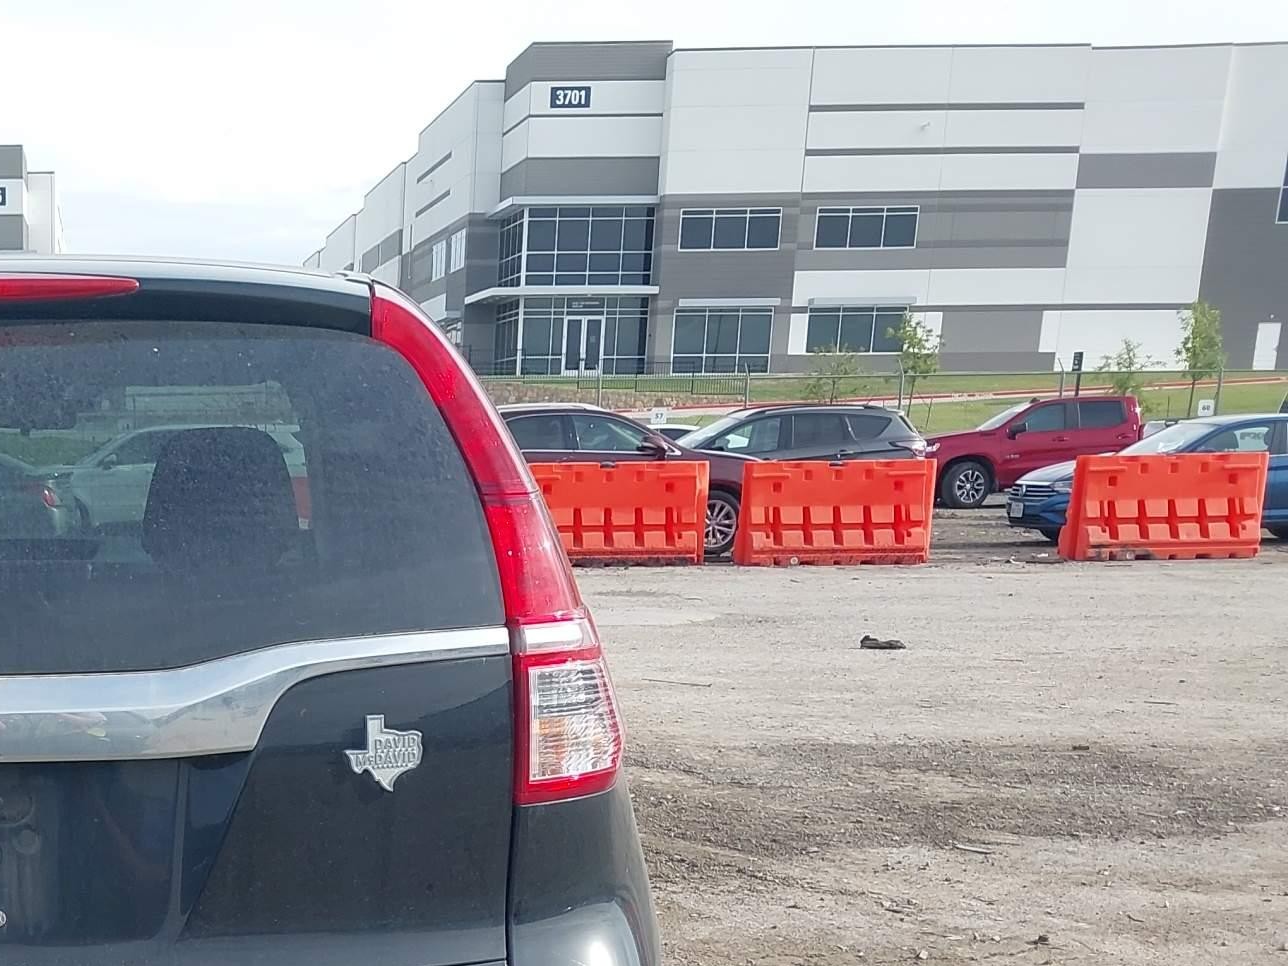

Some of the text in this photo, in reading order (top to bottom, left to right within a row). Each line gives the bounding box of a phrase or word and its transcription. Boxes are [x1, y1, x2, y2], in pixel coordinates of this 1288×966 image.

[555, 90, 586, 105] 3701
[374, 735, 417, 750] DAVID
[355, 750, 417, 768] McDAVID
